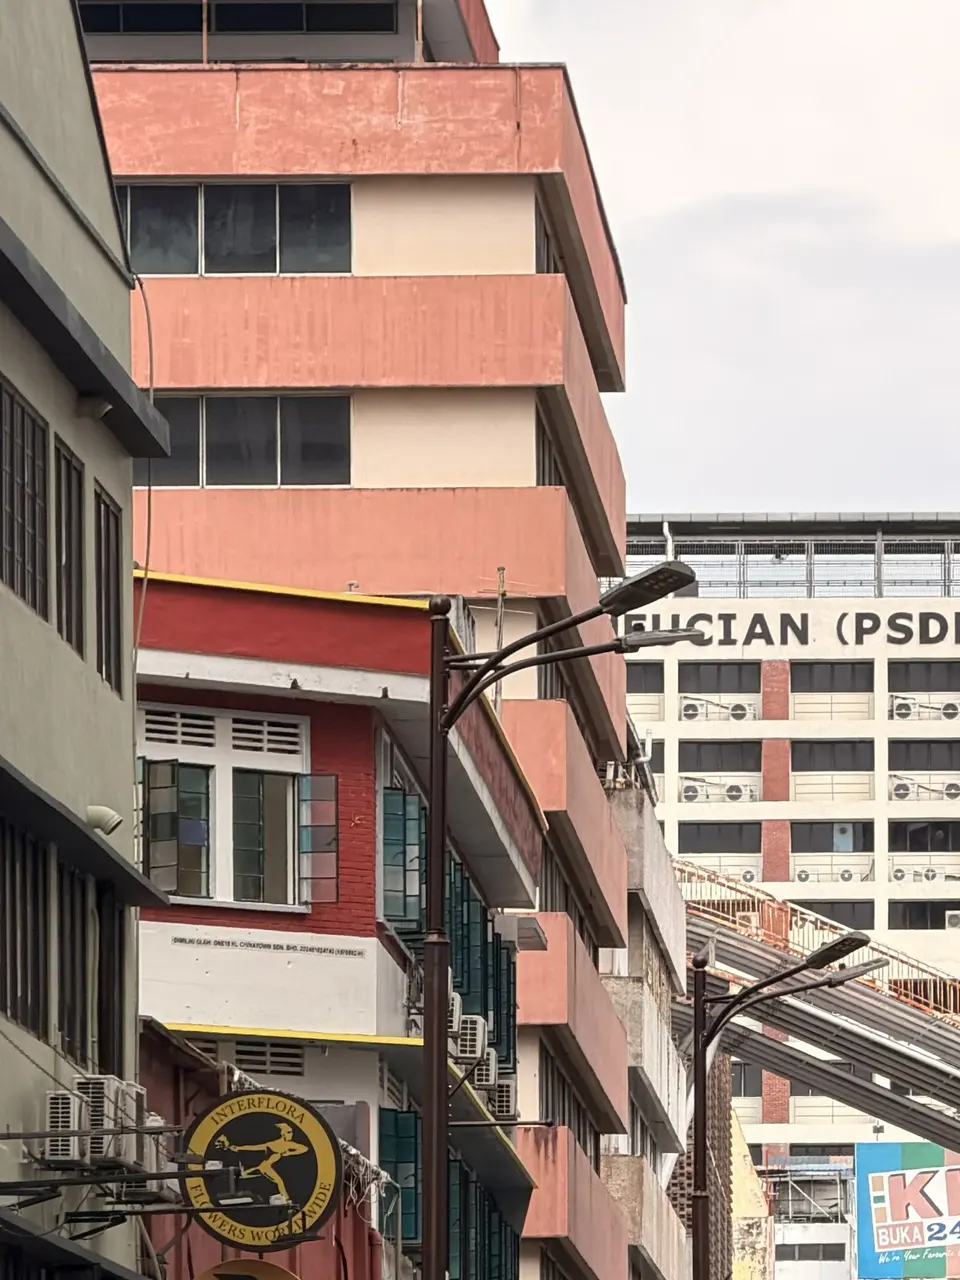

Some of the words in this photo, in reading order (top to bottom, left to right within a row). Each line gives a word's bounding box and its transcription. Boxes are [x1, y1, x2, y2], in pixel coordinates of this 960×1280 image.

[211, 1096, 306, 1126] INTERFLORA
[878, 1225, 923, 1247] BUKA
[903, 1250, 921, 1262] Your
